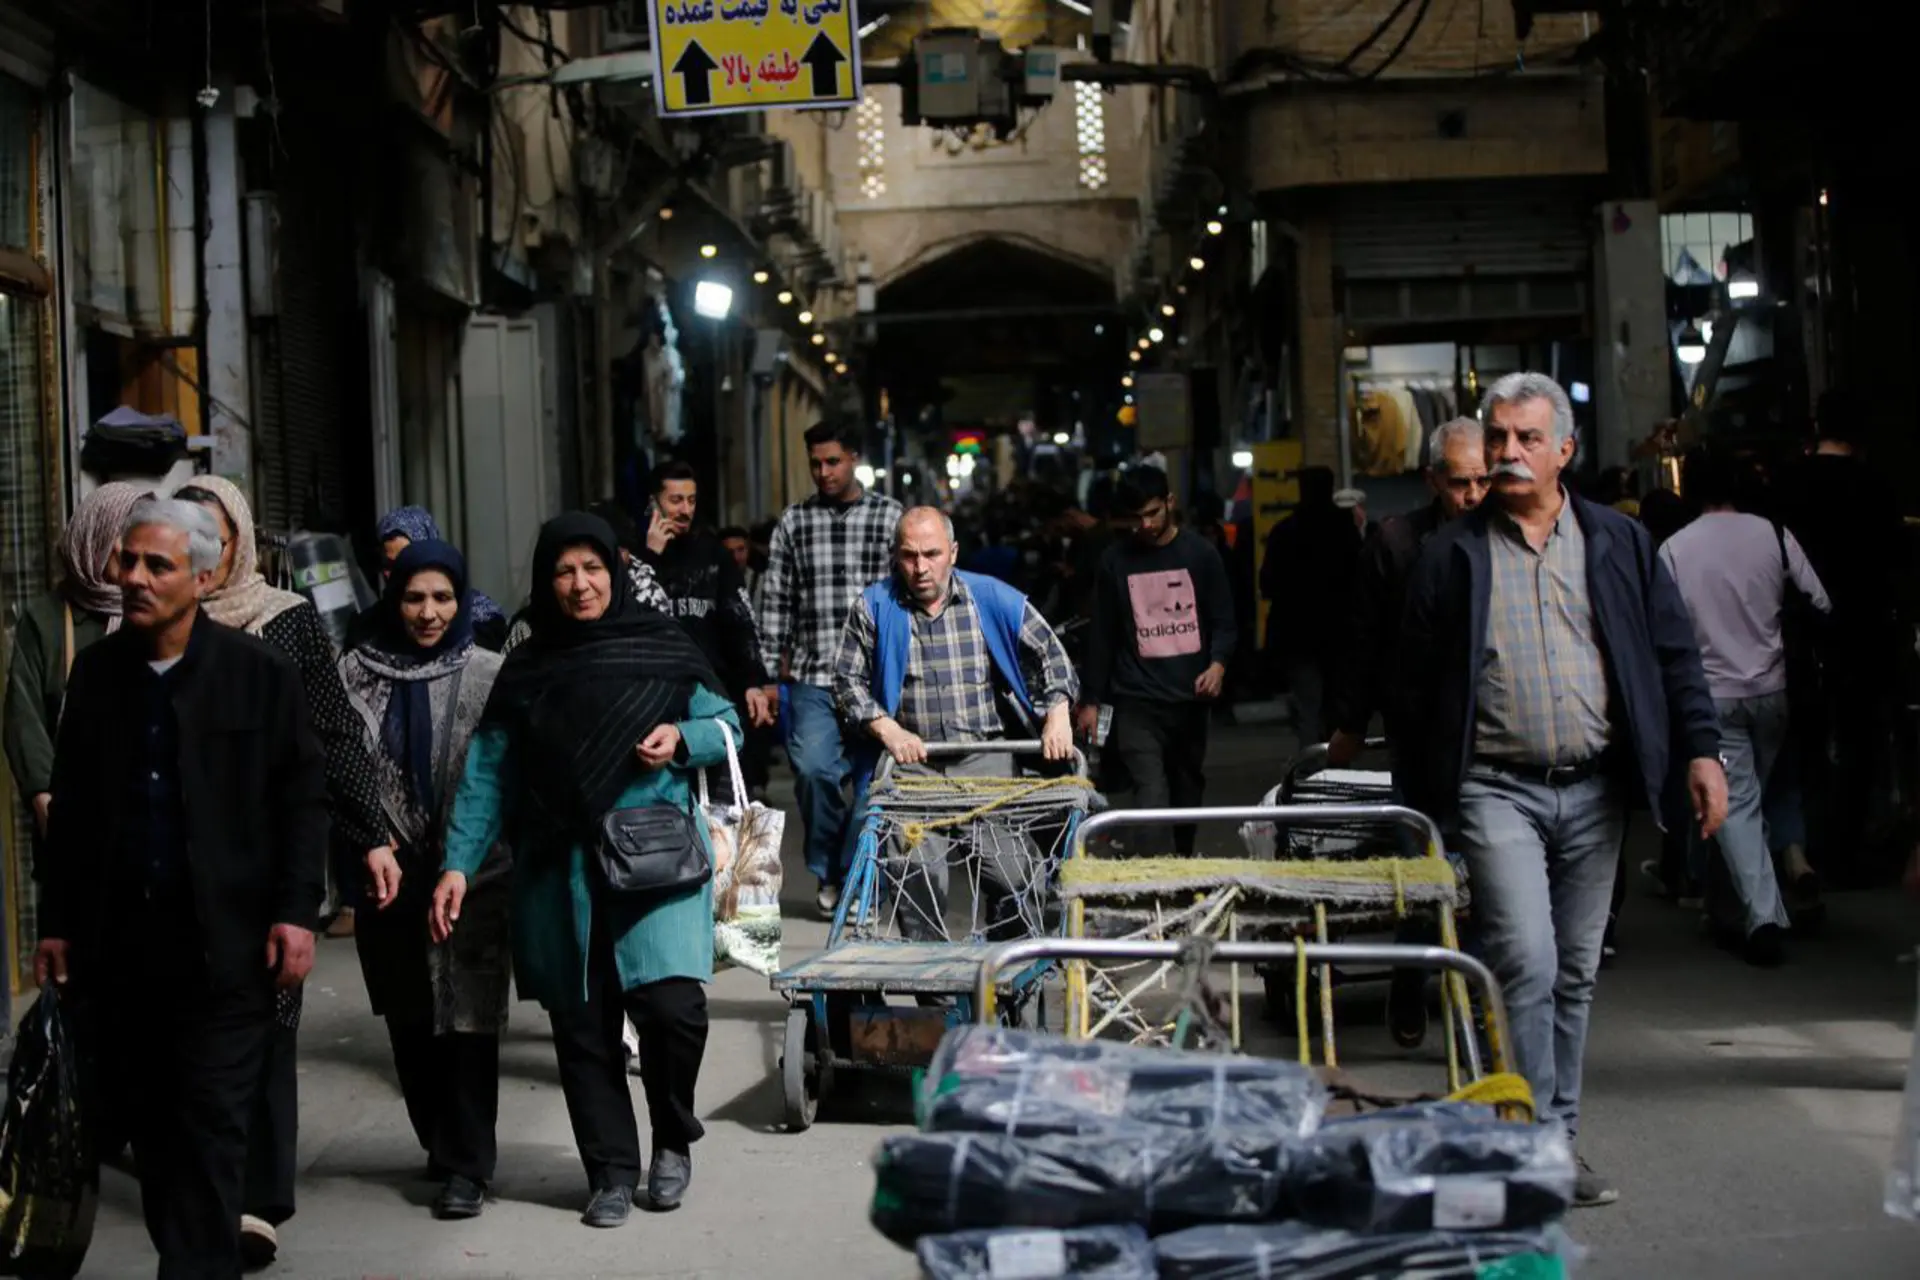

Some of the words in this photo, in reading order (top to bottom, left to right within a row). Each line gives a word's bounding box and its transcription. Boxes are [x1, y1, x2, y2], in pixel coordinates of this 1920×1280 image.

[666, 0, 713, 24] عمده
[722, 53, 751, 92] بالا
[758, 51, 799, 90] طبقه
[1139, 621, 1196, 638] adidas
